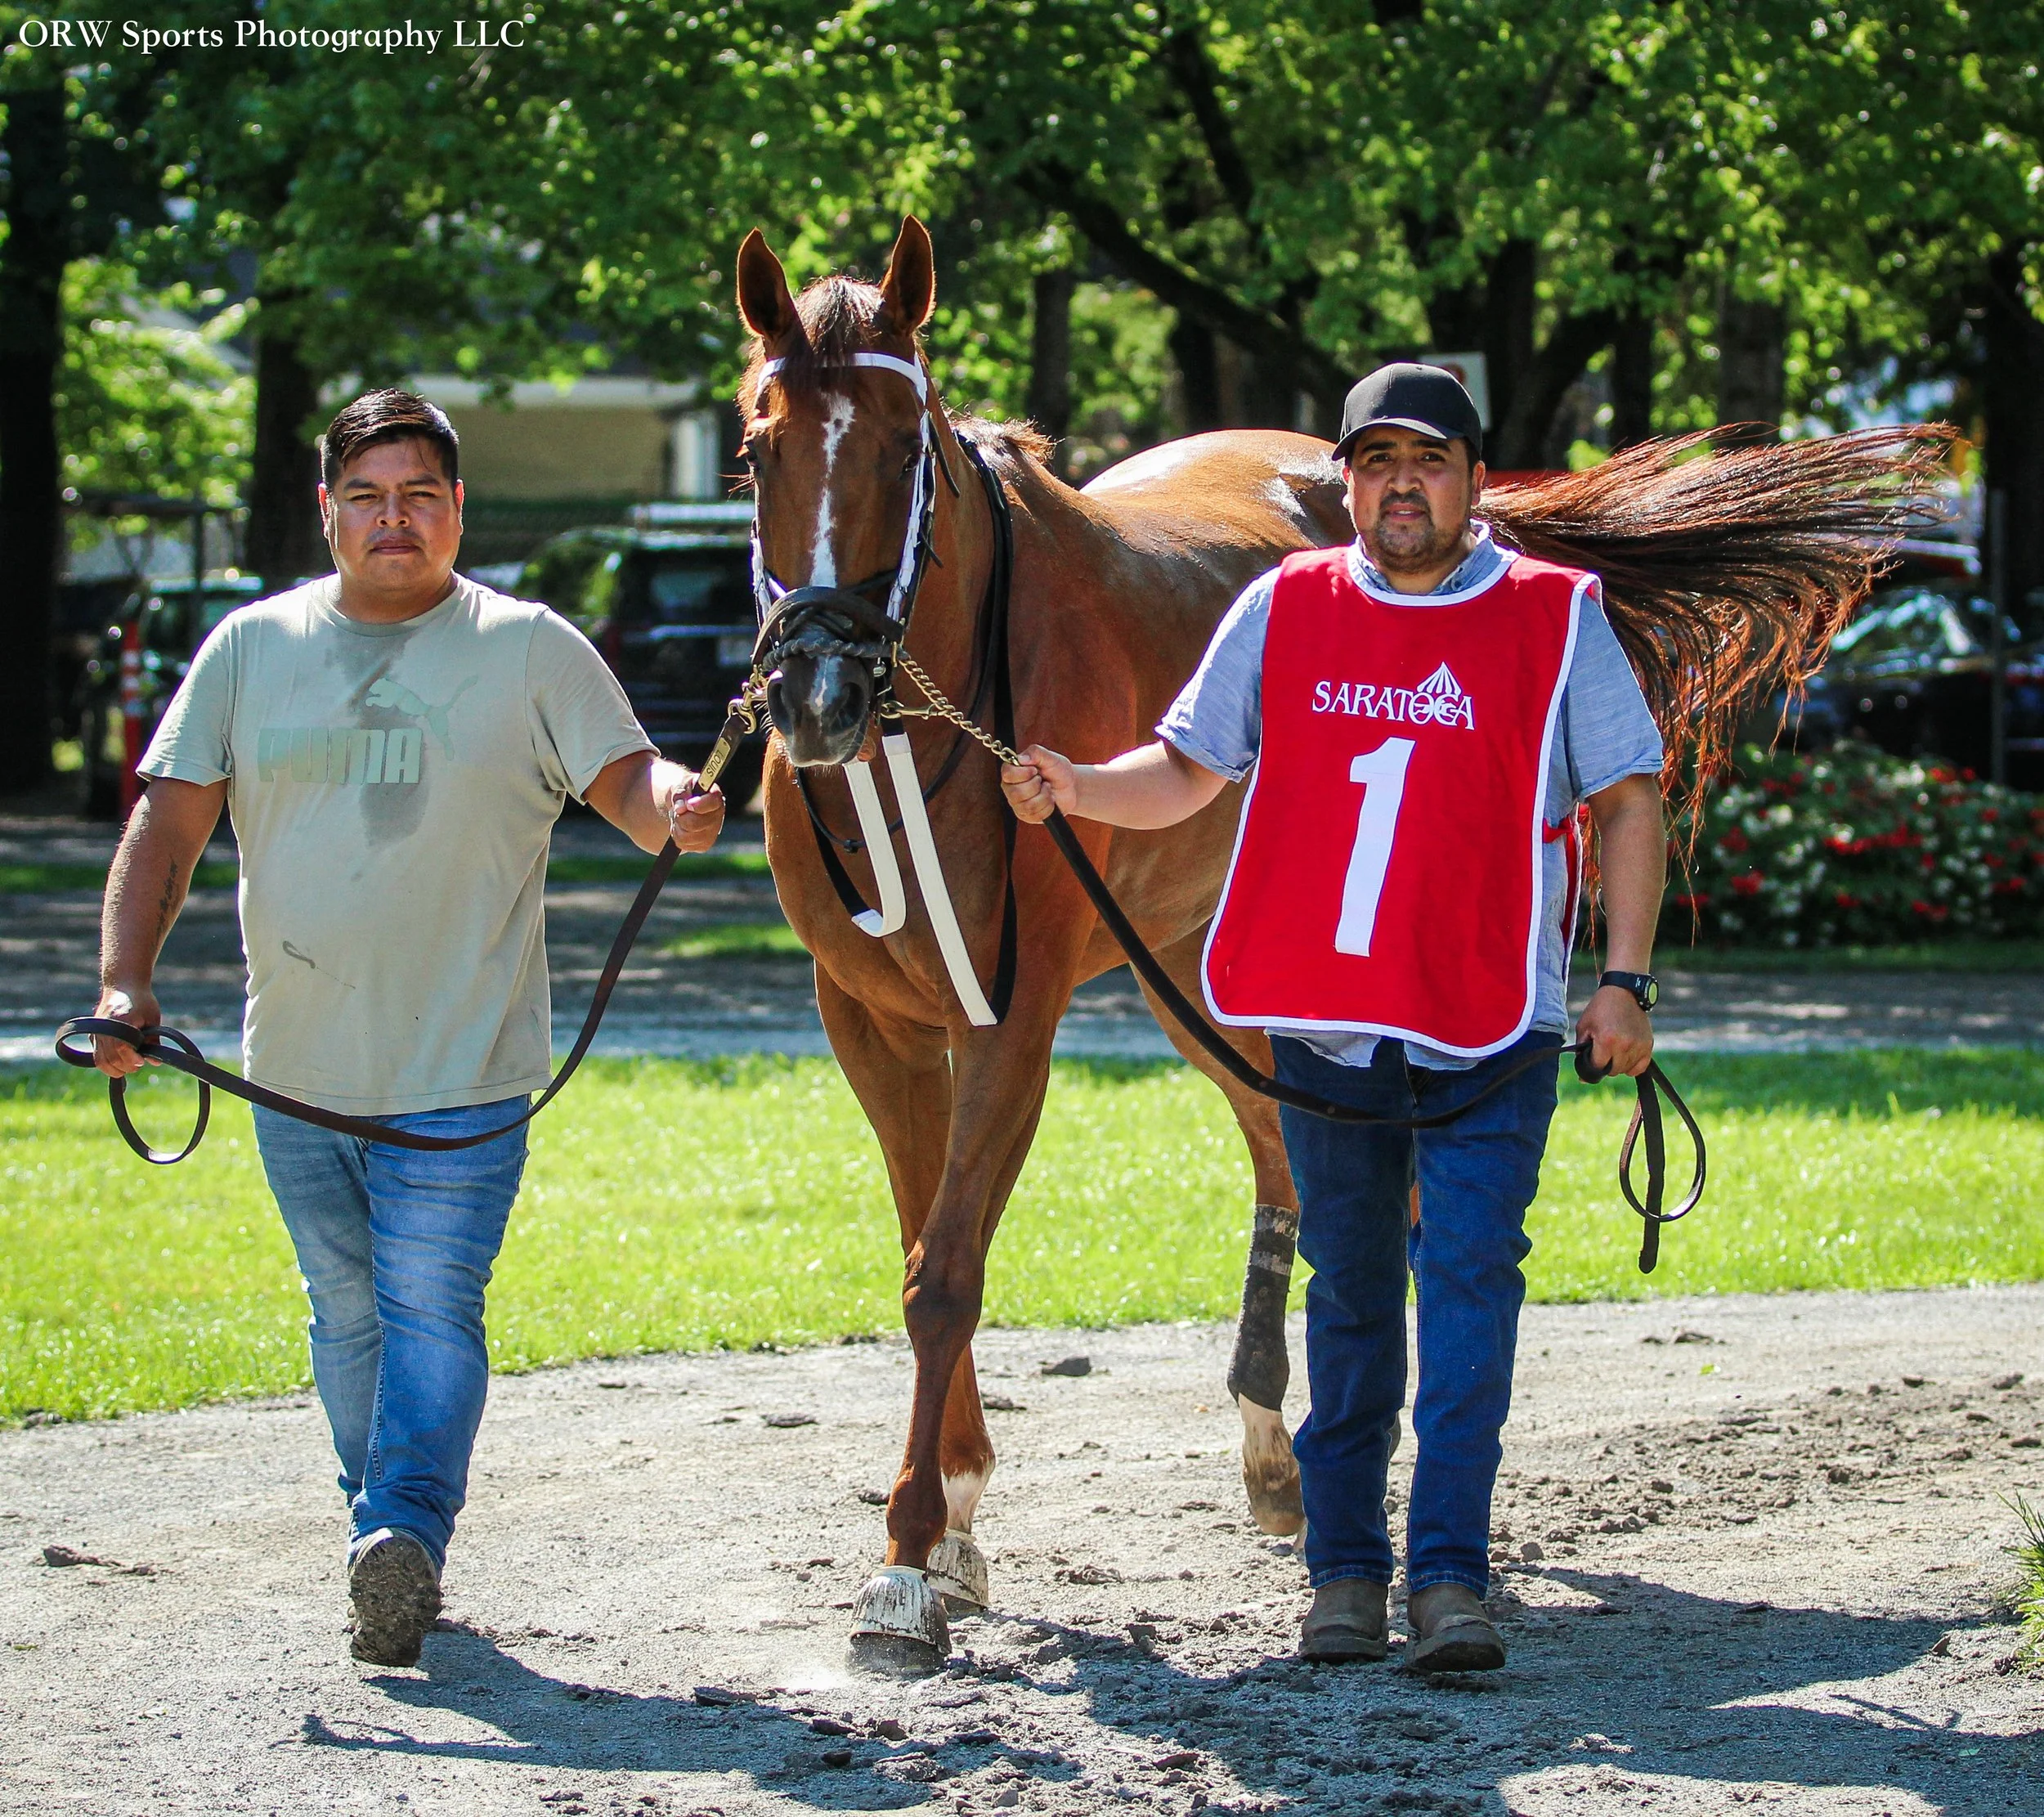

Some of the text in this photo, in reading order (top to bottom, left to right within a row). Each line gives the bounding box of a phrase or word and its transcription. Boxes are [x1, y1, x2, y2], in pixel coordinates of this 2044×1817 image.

[1311, 680, 1475, 730] SARATOGA
[258, 727, 424, 785] PUMA
[706, 749, 724, 777] LOUIS
[1334, 736, 1416, 958] 1
